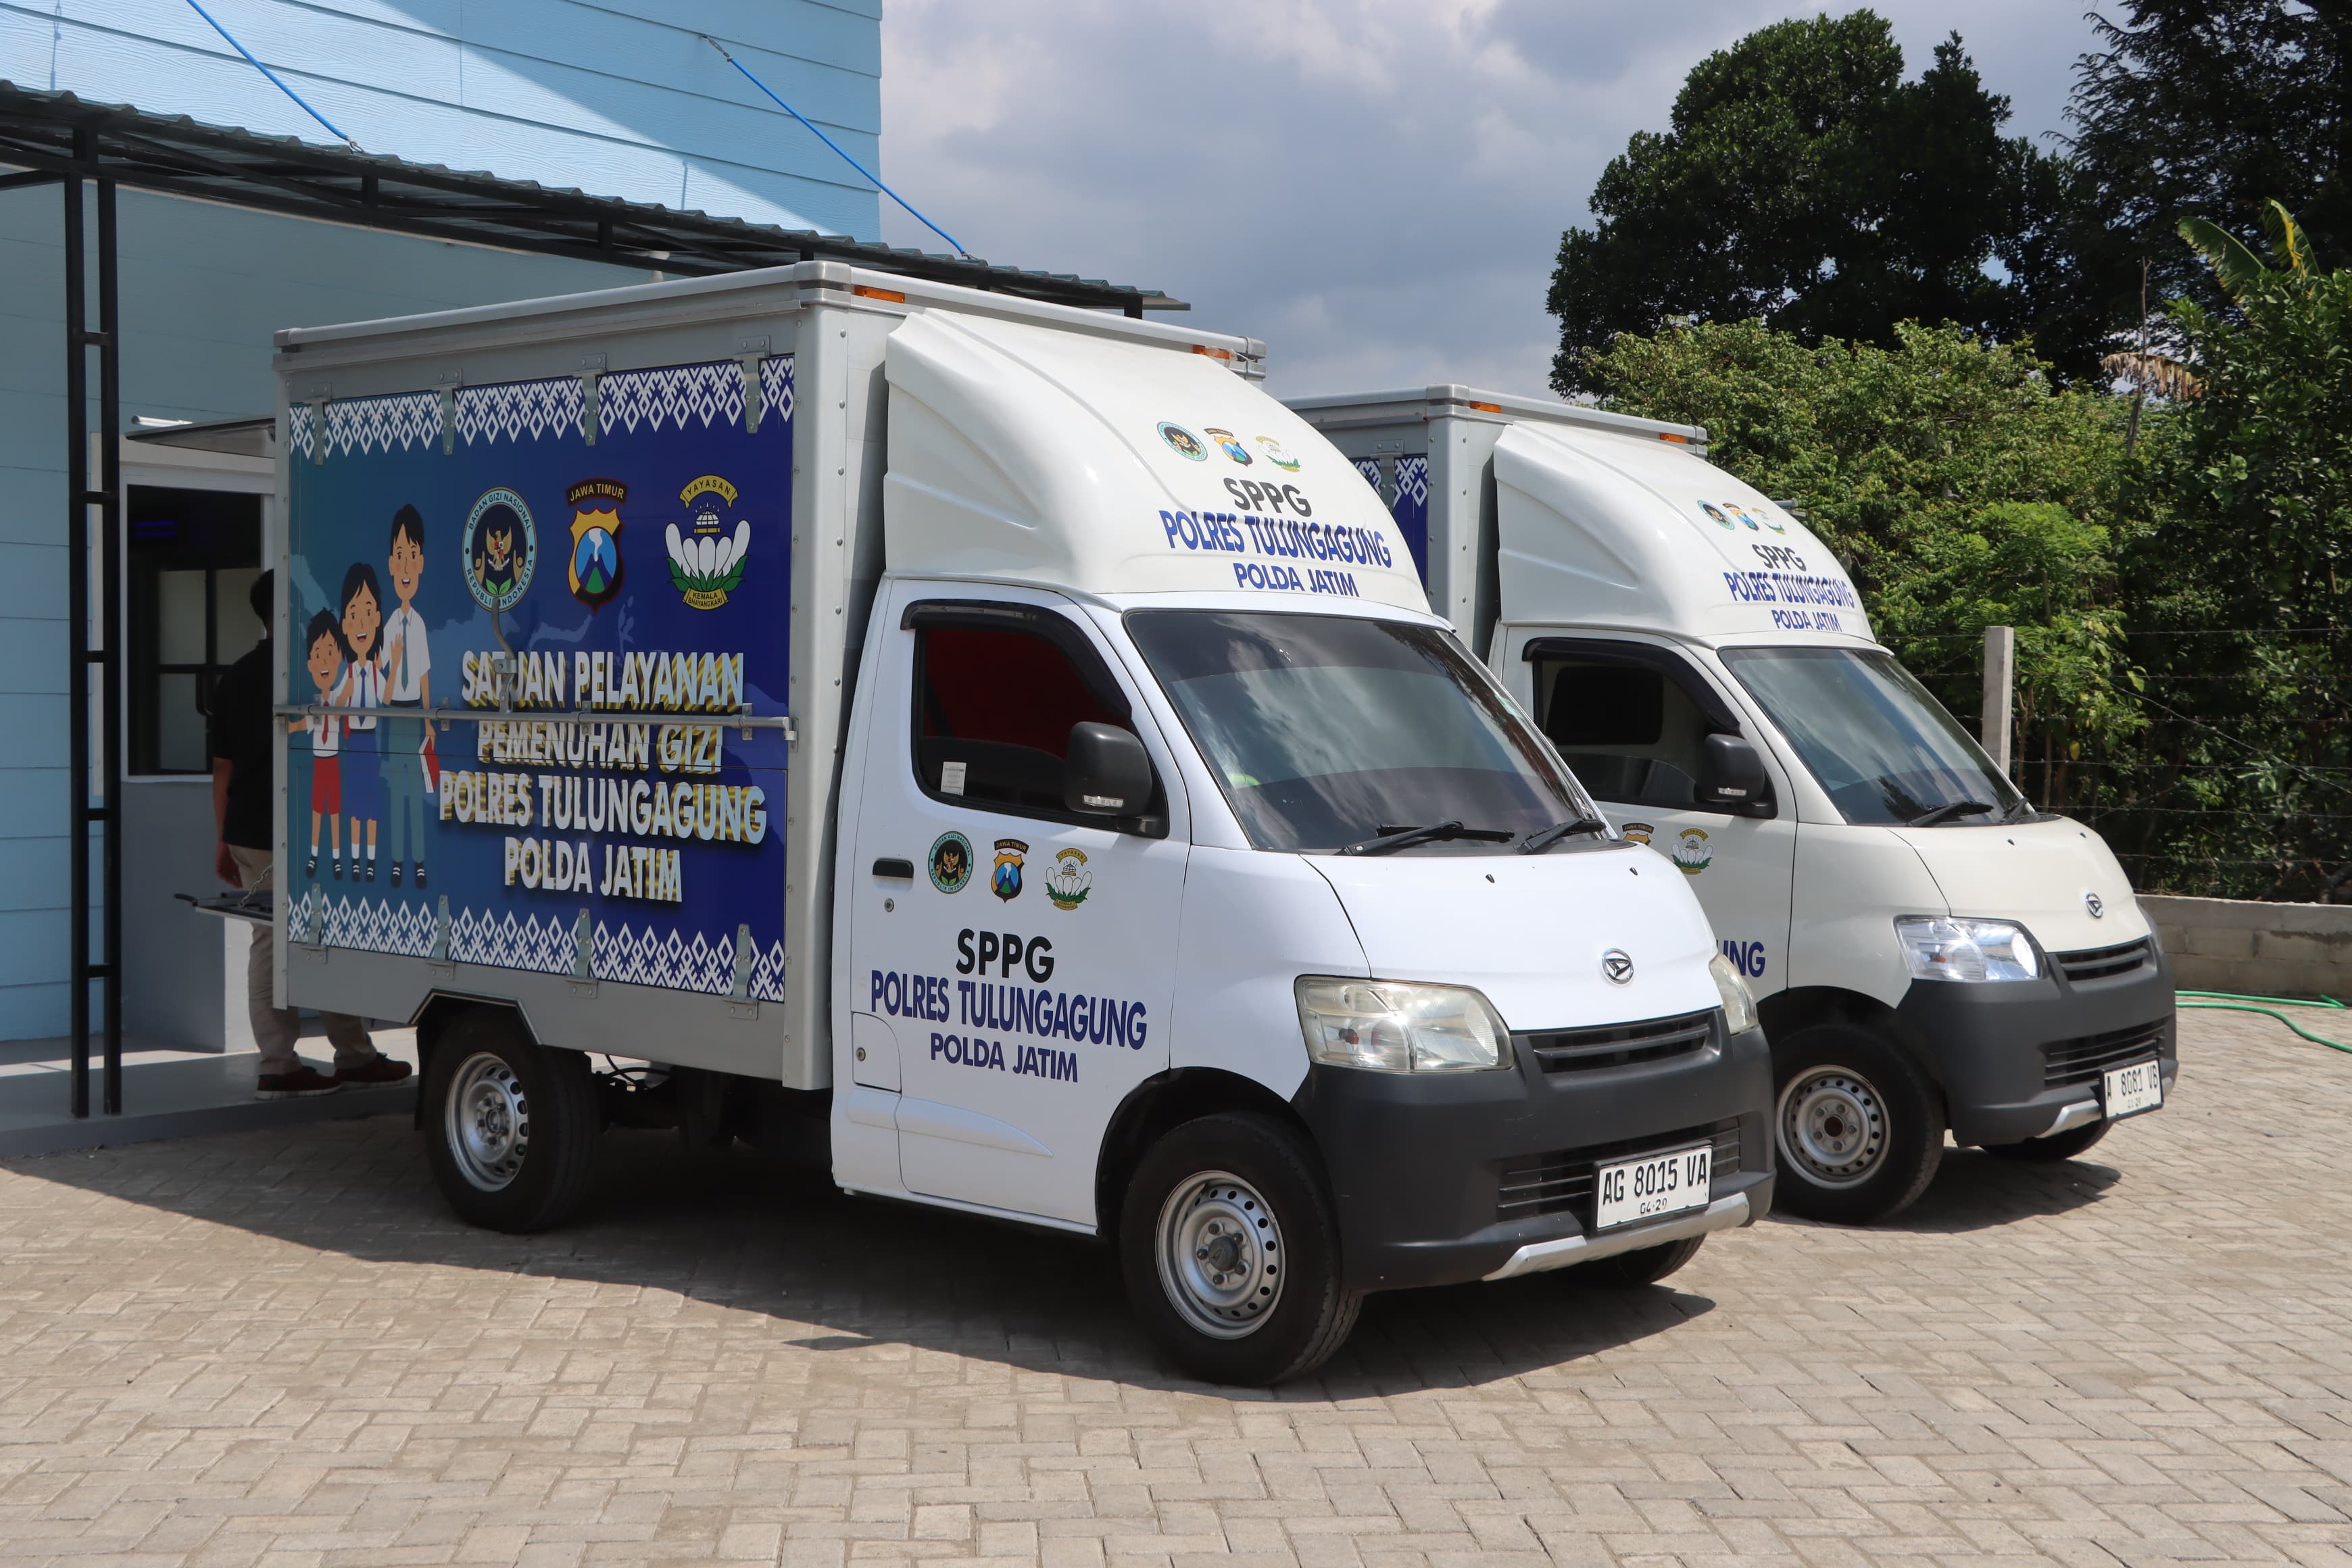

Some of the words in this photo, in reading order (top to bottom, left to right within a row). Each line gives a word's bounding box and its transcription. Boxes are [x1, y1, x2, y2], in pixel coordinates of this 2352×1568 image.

[570, 485, 594, 501] JAWA
[596, 483, 624, 499] TIMUR
[687, 479, 731, 495] YAYASAN
[1223, 477, 1312, 517] SPPG
[468, 499, 487, 530] BADAN
[489, 493, 502, 502] GIZI
[504, 493, 532, 531] NASIONAL
[1158, 510, 1245, 553] POLRES
[1244, 515, 1392, 568] TULUNGAGUNG
[1752, 543, 1807, 571] SPPG
[467, 568, 492, 605] REPUBLI
[1232, 562, 1305, 591] POLDA
[1307, 568, 1359, 597] JATIM
[1723, 572, 1777, 602] POLRES
[1772, 573, 1855, 609] TULUNGAGUNG
[688, 597, 722, 607] BHAYANGKARI
[1771, 609, 1813, 629] POLDA
[1811, 612, 1843, 632] JATIM
[574, 651, 744, 712] PELAYANAN
[477, 720, 650, 770] PEMENUHAN
[656, 725, 723, 773] GIZI
[439, 769, 533, 827] POLRES
[538, 775, 767, 844] TULUNGAGUNG
[996, 840, 1010, 848] JAWA
[1011, 841, 1027, 852] TIMUR
[505, 836, 593, 893] POLDA
[600, 844, 682, 902] JATIM
[956, 928, 1054, 983] SPPG
[871, 969, 950, 1023] POLRES
[958, 980, 1147, 1050] TULUNGAGUNG
[931, 1032, 1006, 1071] POLDA
[1012, 1045, 1078, 1083] JATIM
[2121, 1068, 2142, 1096] 8081
[2147, 1064, 2159, 1089] VB
[1602, 1169, 1625, 1206] AG
[1634, 1158, 1678, 1198] 8015
[1687, 1153, 1707, 1187] VA
